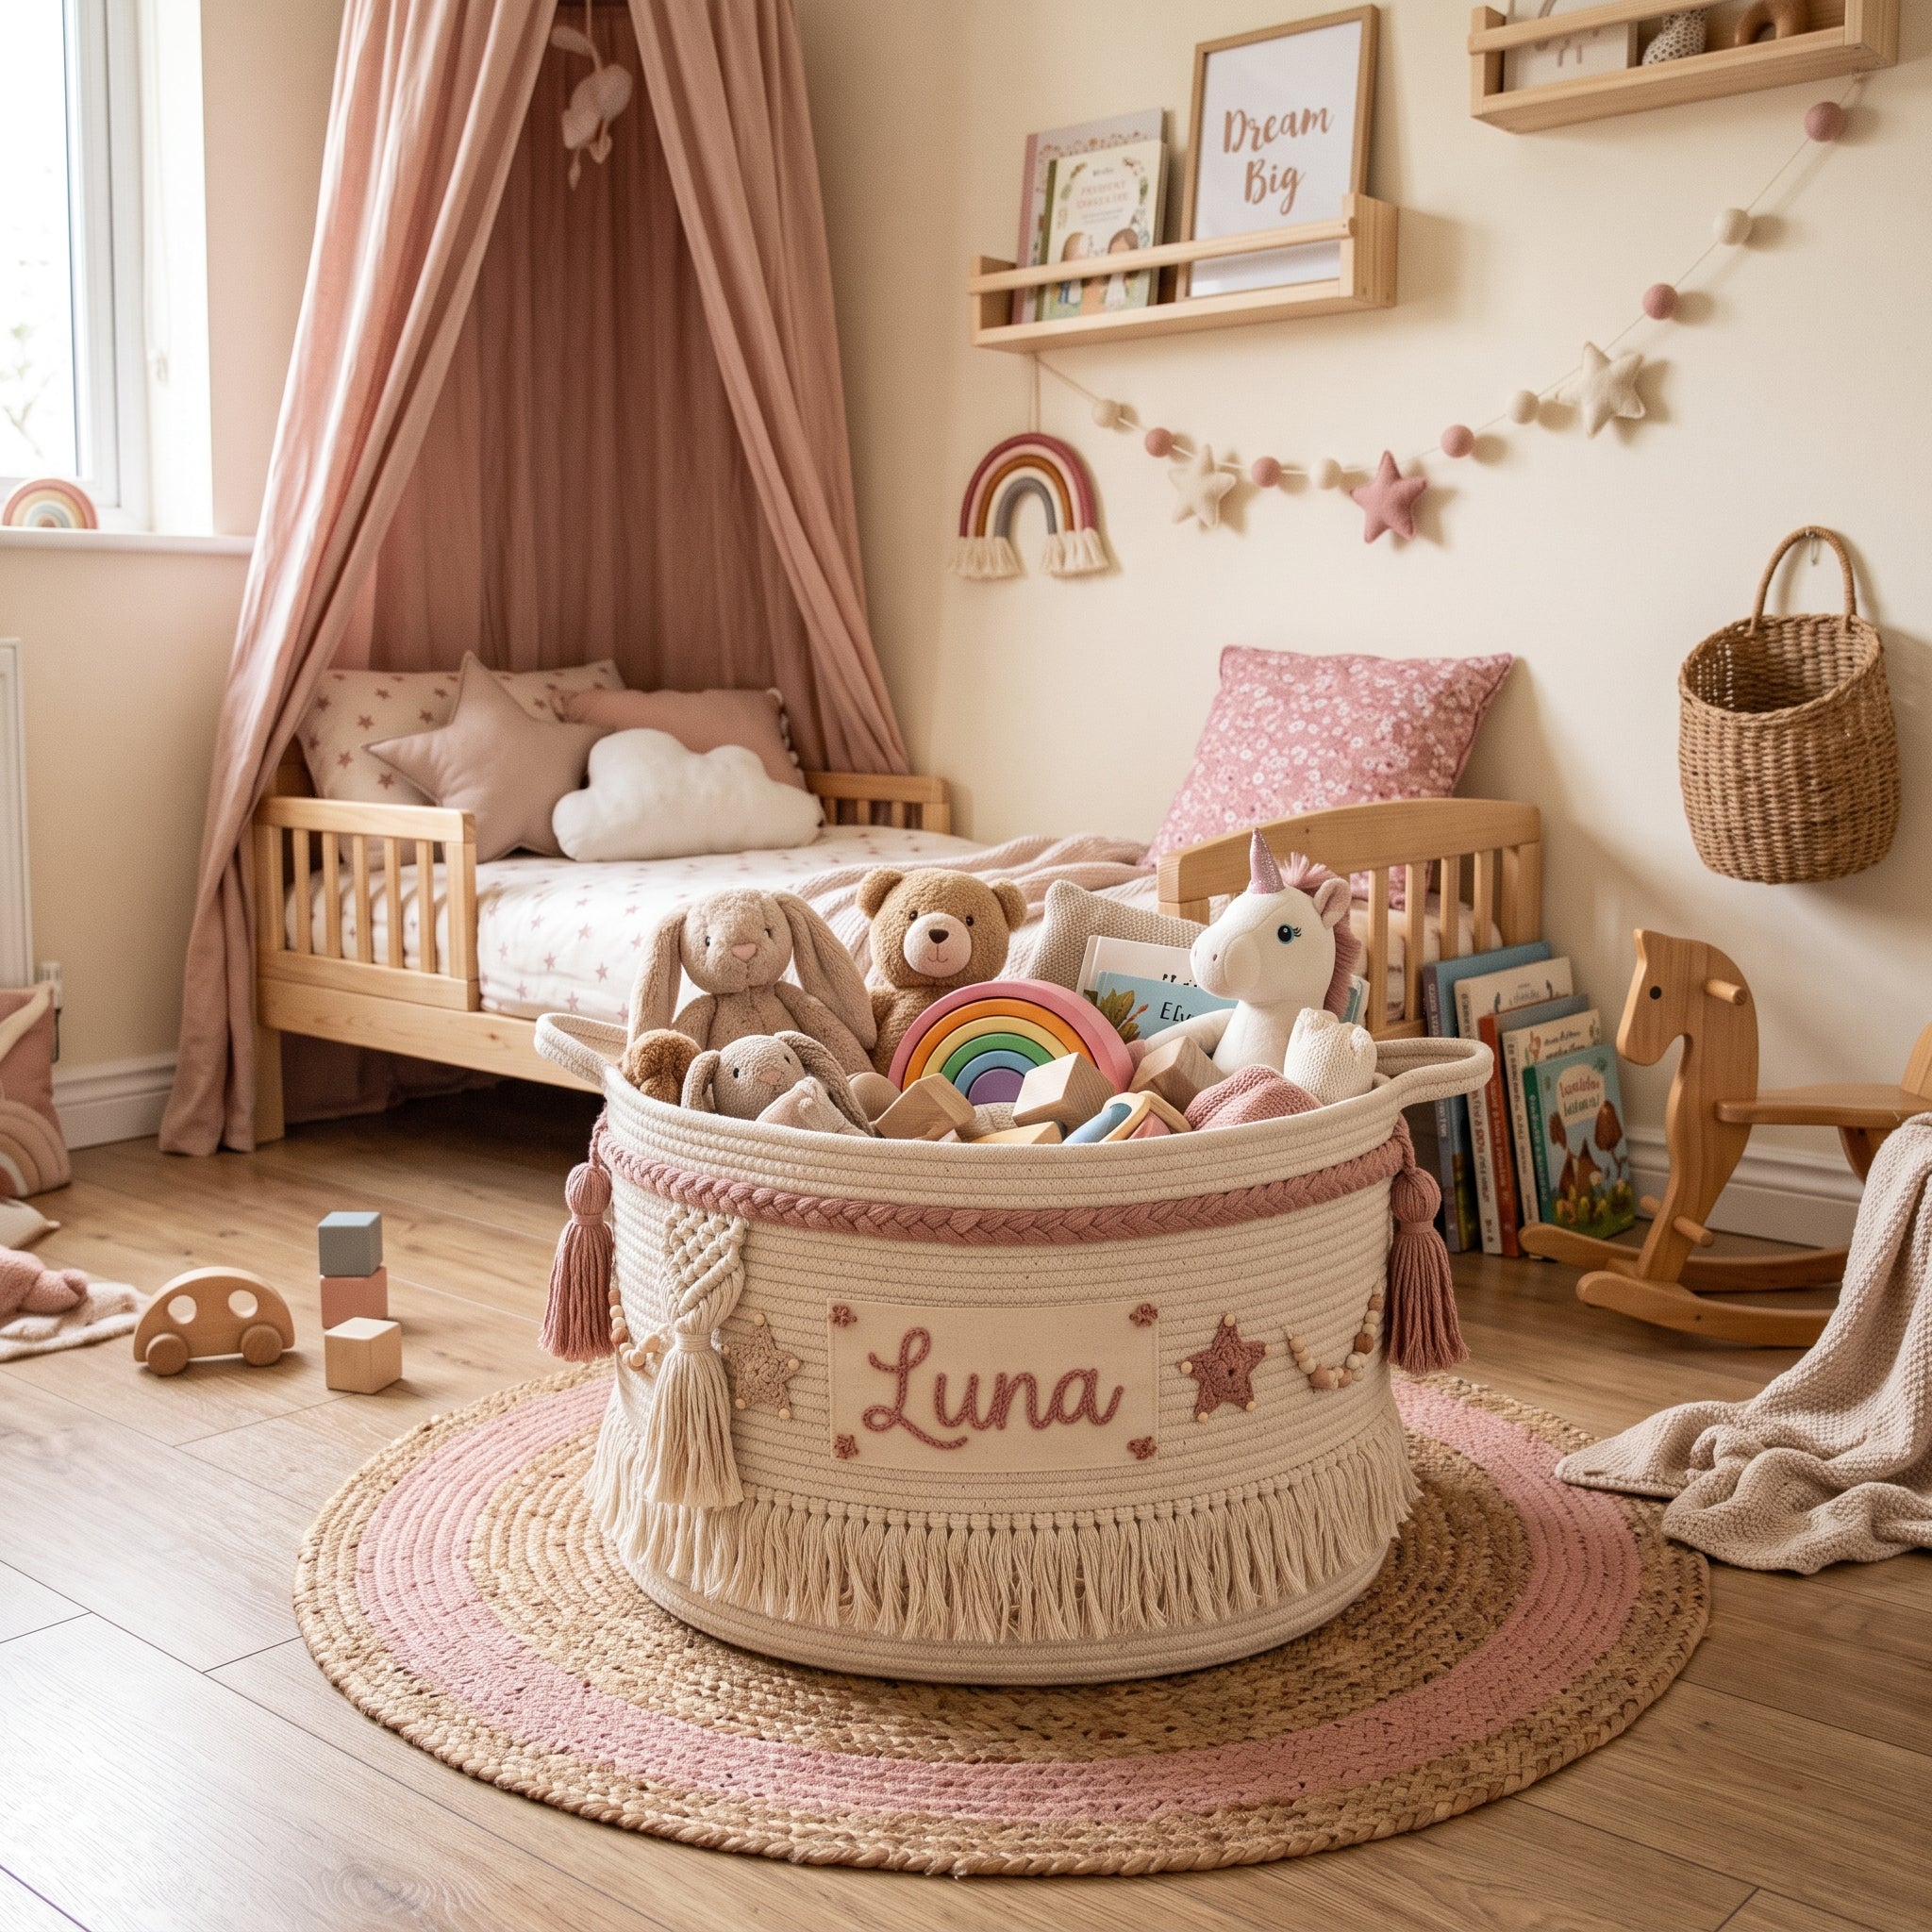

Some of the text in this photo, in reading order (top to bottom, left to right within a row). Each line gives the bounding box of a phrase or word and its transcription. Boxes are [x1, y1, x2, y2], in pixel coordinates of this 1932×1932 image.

[1223, 107, 1335, 154] Dream
[1244, 158, 1306, 216] Big
[861, 1326, 1124, 1451] Luna
